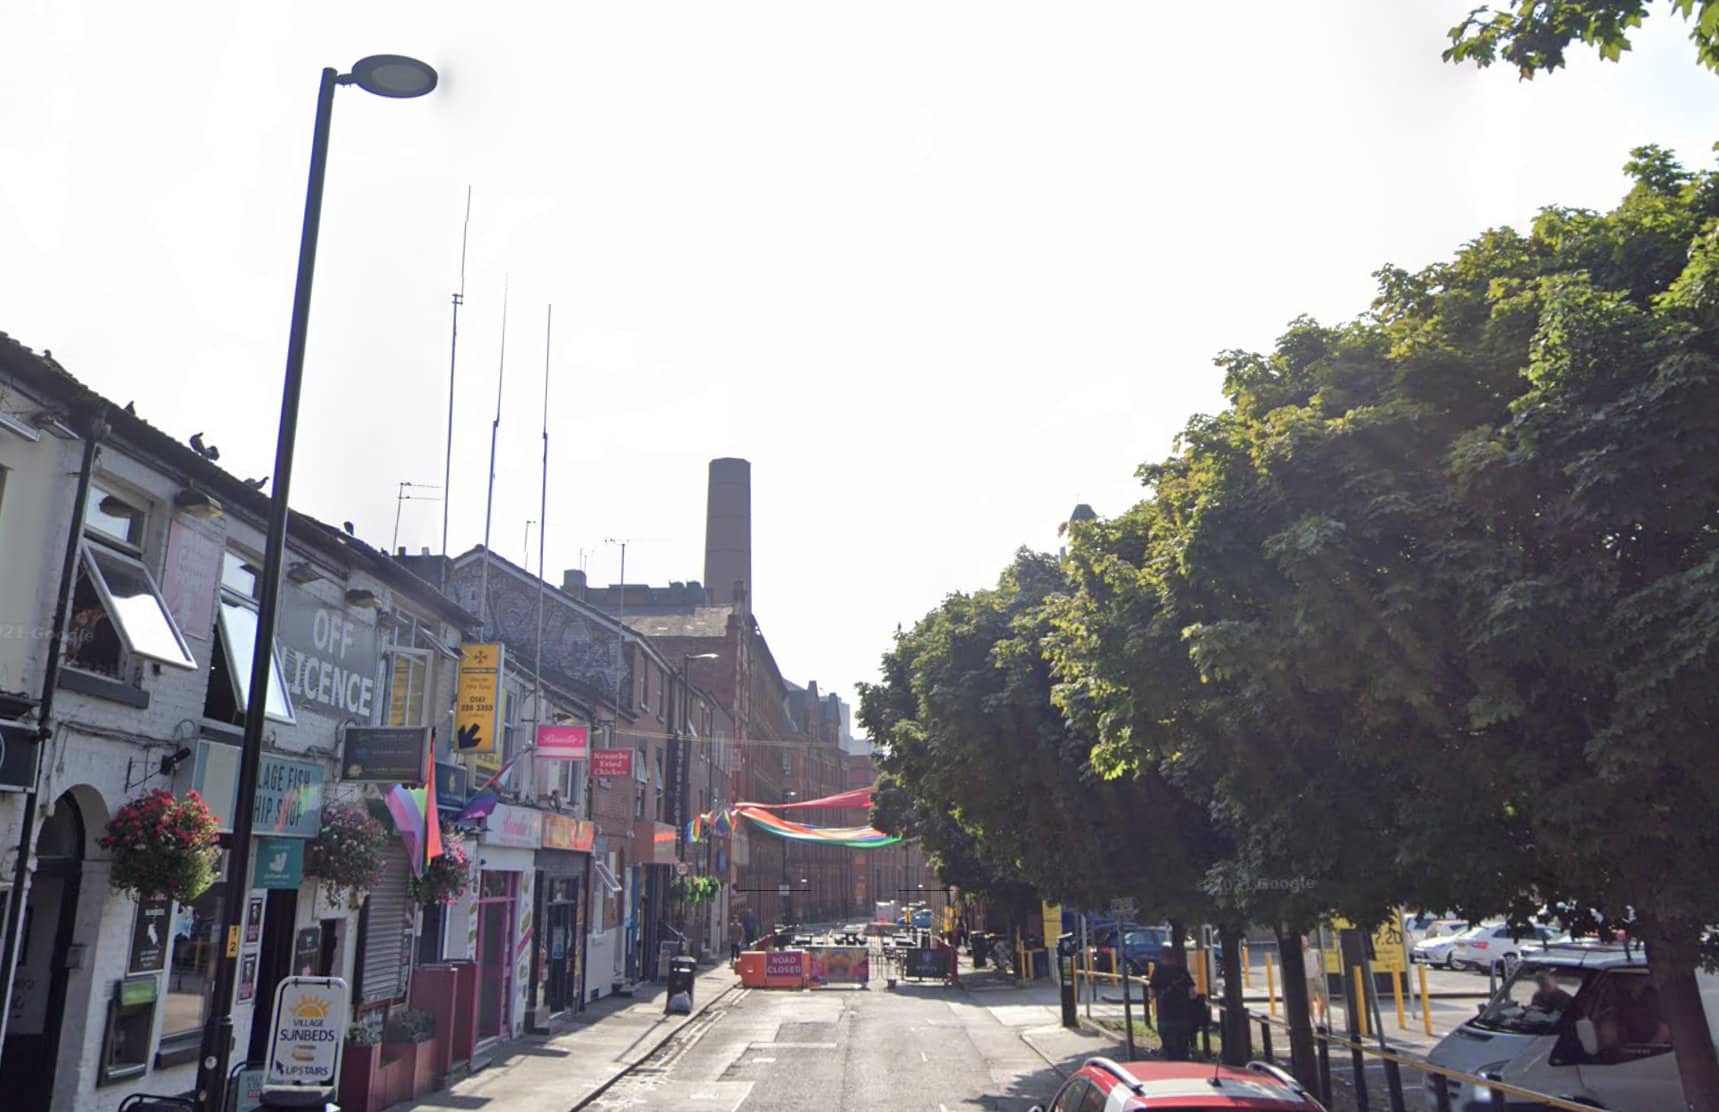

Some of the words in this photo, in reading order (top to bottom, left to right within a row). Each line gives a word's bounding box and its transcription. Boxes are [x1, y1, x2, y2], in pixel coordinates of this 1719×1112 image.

[313, 607, 354, 659] OFF
[281, 646, 373, 717] LICENCE
[772, 956, 796, 964] ROAD
[767, 965, 801, 975] CLOSED
[293, 1018, 325, 1028] VILLAGE
[279, 1028, 335, 1042] SUNBEDS
[285, 1064, 329, 1076] UPSTAIRS
